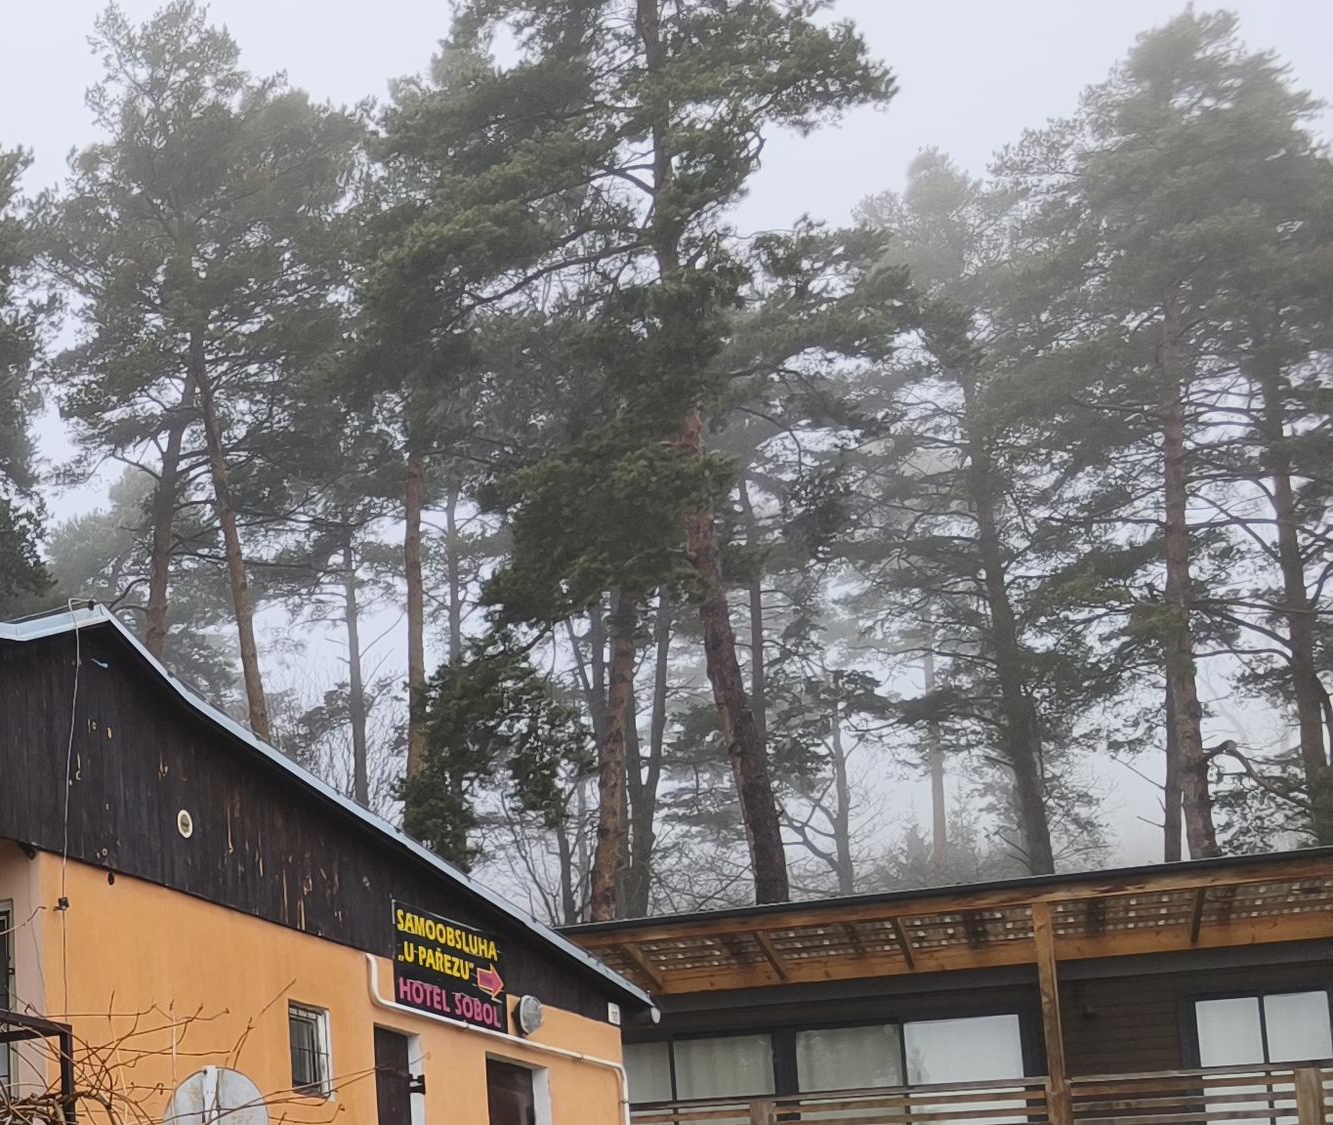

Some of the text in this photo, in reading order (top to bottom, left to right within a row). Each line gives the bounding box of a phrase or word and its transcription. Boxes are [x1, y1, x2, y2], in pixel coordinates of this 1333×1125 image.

[396, 908, 498, 961] SAMOOBSLUHA
[398, 976, 502, 1028] HOTEL SOBOL
